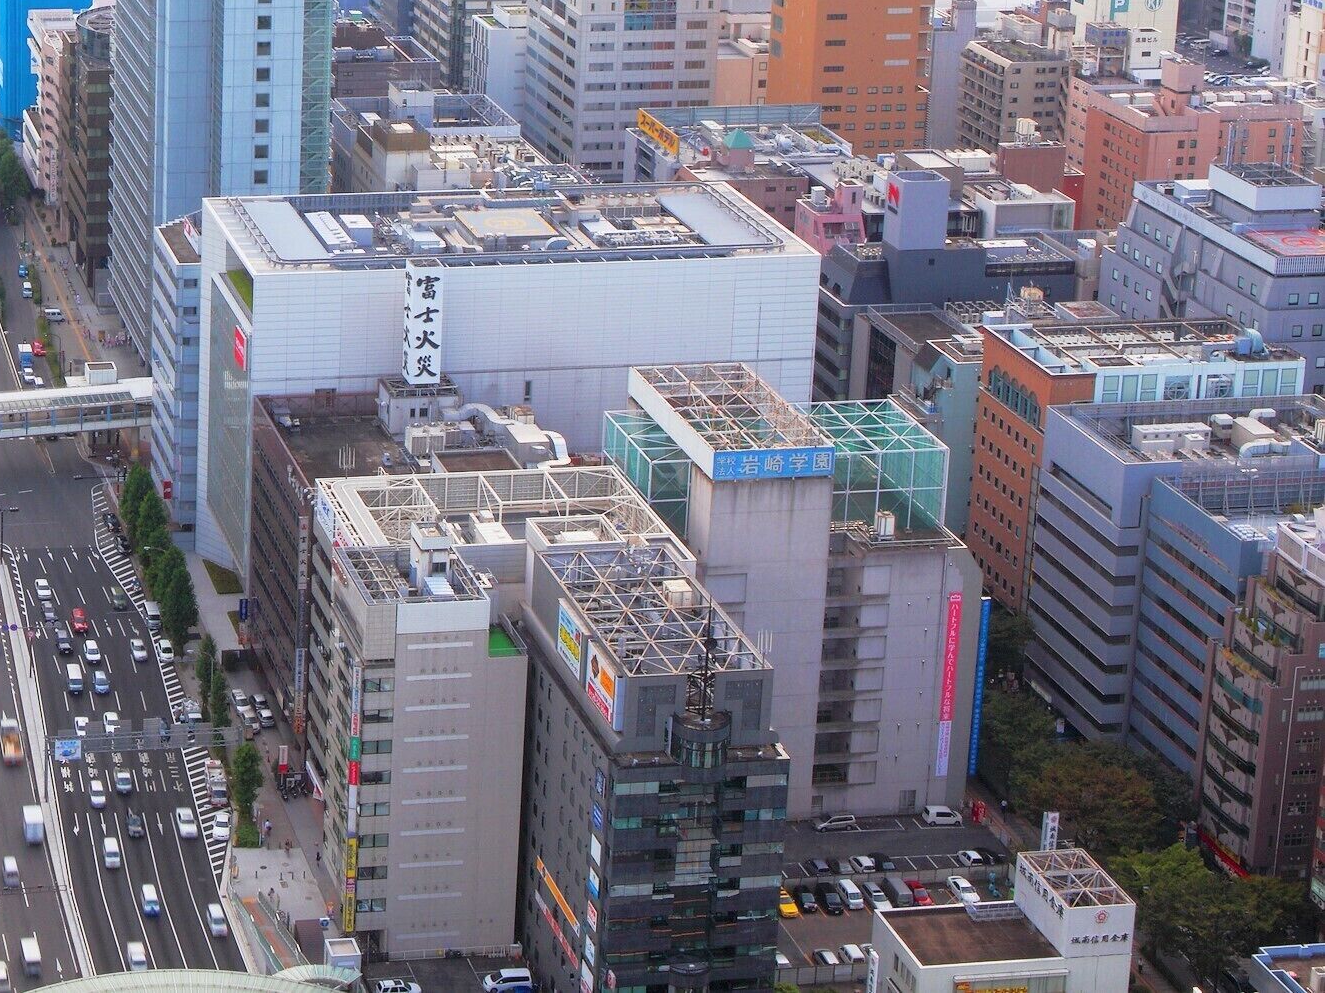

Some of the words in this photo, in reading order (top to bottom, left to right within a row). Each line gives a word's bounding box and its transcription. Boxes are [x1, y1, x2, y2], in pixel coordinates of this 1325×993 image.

[639, 113, 676, 150] スーパーホテル
[413, 275, 441, 378] 富士火災
[716, 457, 736, 466] 学校
[716, 468, 736, 476] 法人
[740, 452, 832, 475] 岩崎学園
[1019, 862, 1066, 921] 城南信用金庫
[1070, 932, 1131, 944] 城南信用金庫
